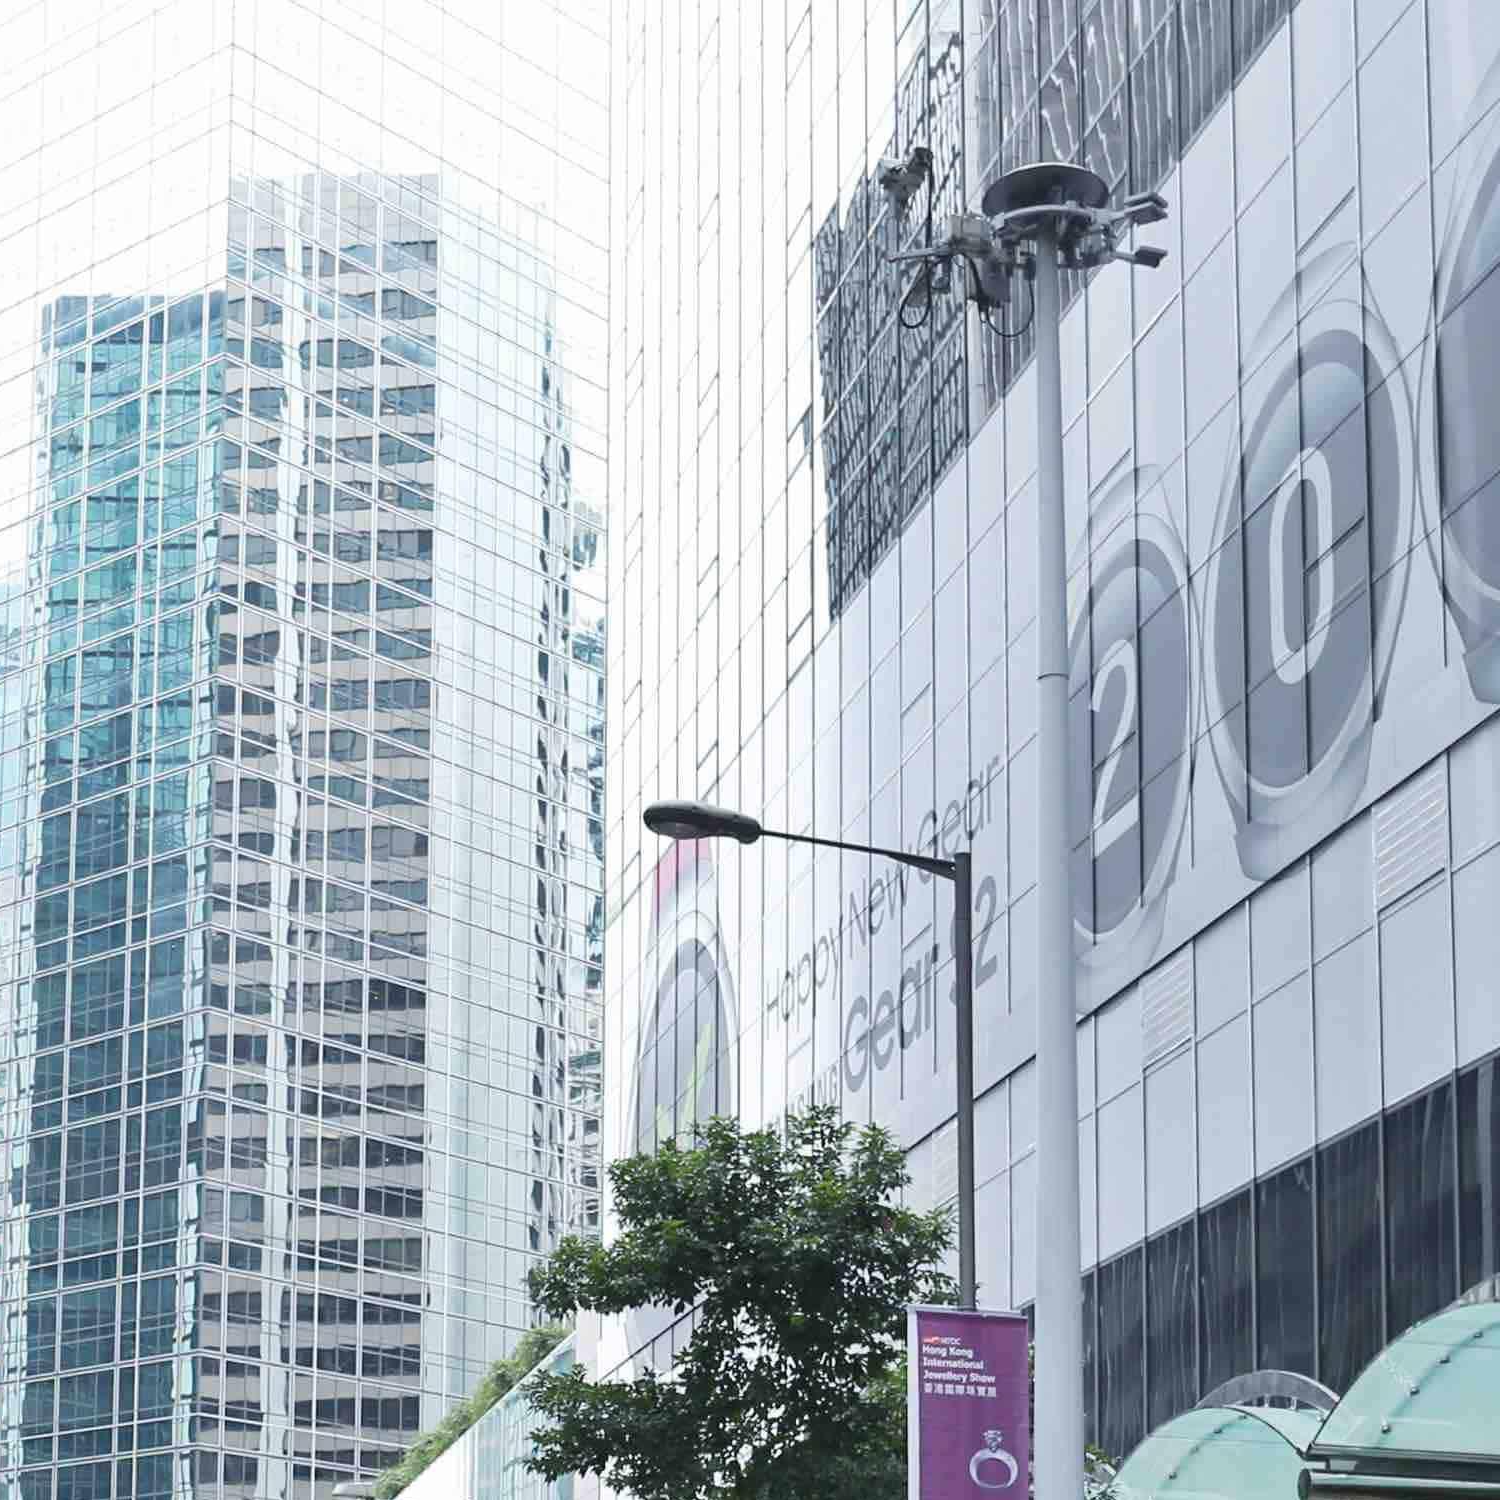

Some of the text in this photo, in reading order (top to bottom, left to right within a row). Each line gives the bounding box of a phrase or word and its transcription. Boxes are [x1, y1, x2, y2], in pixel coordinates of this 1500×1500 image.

[765, 754, 1000, 1040] Happy New Gear
[843, 943, 940, 1093] Gear
[922, 1344, 973, 1359] Hong Kong
[923, 1357, 984, 1370] International
[923, 1370, 996, 1384] Jewellery Show
